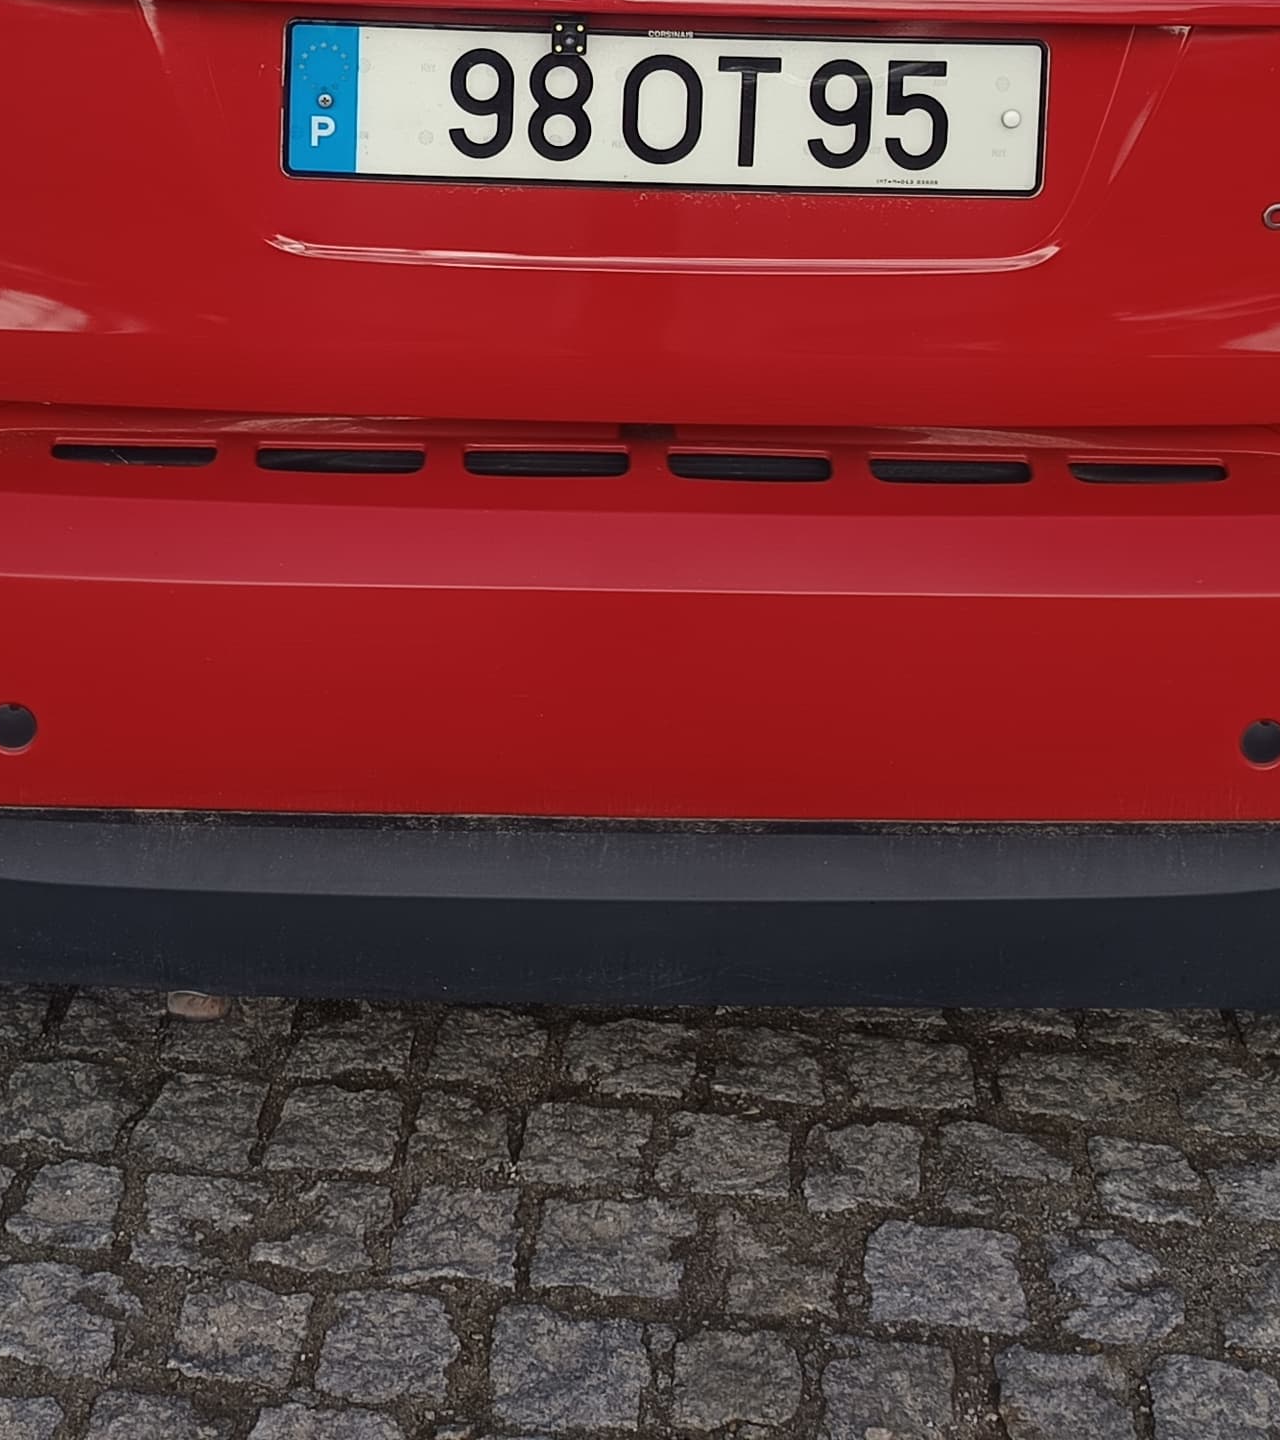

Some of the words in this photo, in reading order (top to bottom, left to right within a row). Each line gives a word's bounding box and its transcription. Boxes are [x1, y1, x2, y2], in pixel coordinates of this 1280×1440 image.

[311, 115, 336, 147] P
[449, 48, 593, 161] 98
[623, 54, 782, 167] OT
[807, 59, 948, 170] 95
